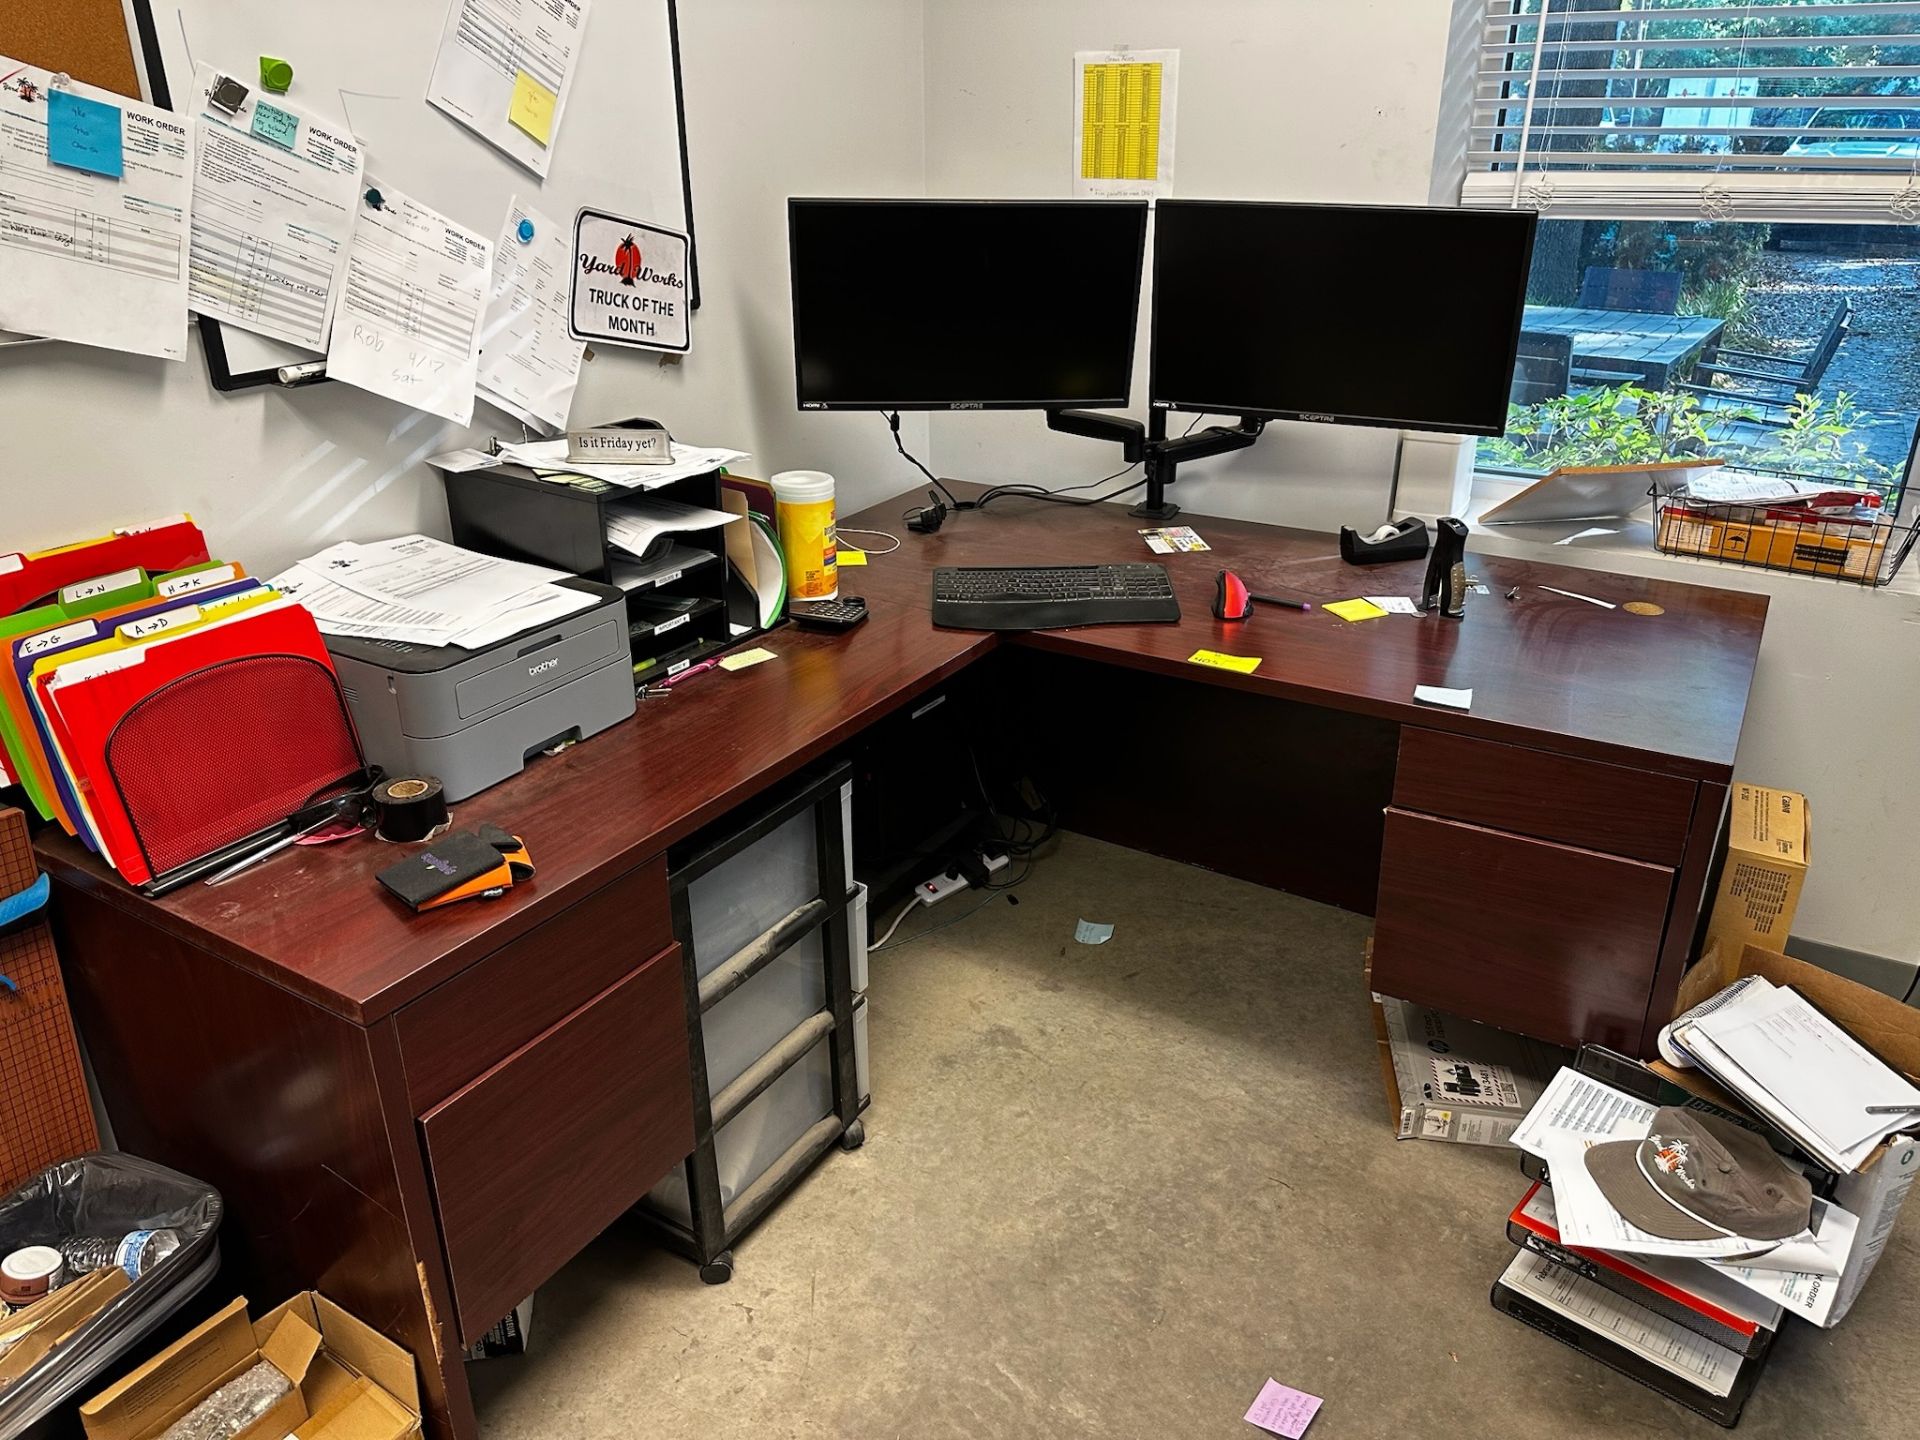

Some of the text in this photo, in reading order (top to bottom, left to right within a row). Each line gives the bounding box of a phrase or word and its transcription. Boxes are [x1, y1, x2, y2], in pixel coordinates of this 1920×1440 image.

[126, 110, 186, 136] WORK ORDER
[308, 125, 357, 153] WORK ORDER
[444, 227, 486, 251] WORK ORDER
[580, 253, 684, 289] Yard Works
[589, 287, 675, 317] TRUCK OF THE
[608, 314, 655, 336] MONTH
[353, 324, 385, 352] Rob
[579, 436, 657, 452] Is it Friday yet?
[98, 585, 105, 593] N
[168, 578, 200, 594] H K
[135, 617, 168, 636] A D
[25, 637, 61, 653] E G
[528, 656, 559, 677] brother
[1481, 1068, 1494, 1097] UN 3481
[1804, 1281, 1821, 1309] ORDER
